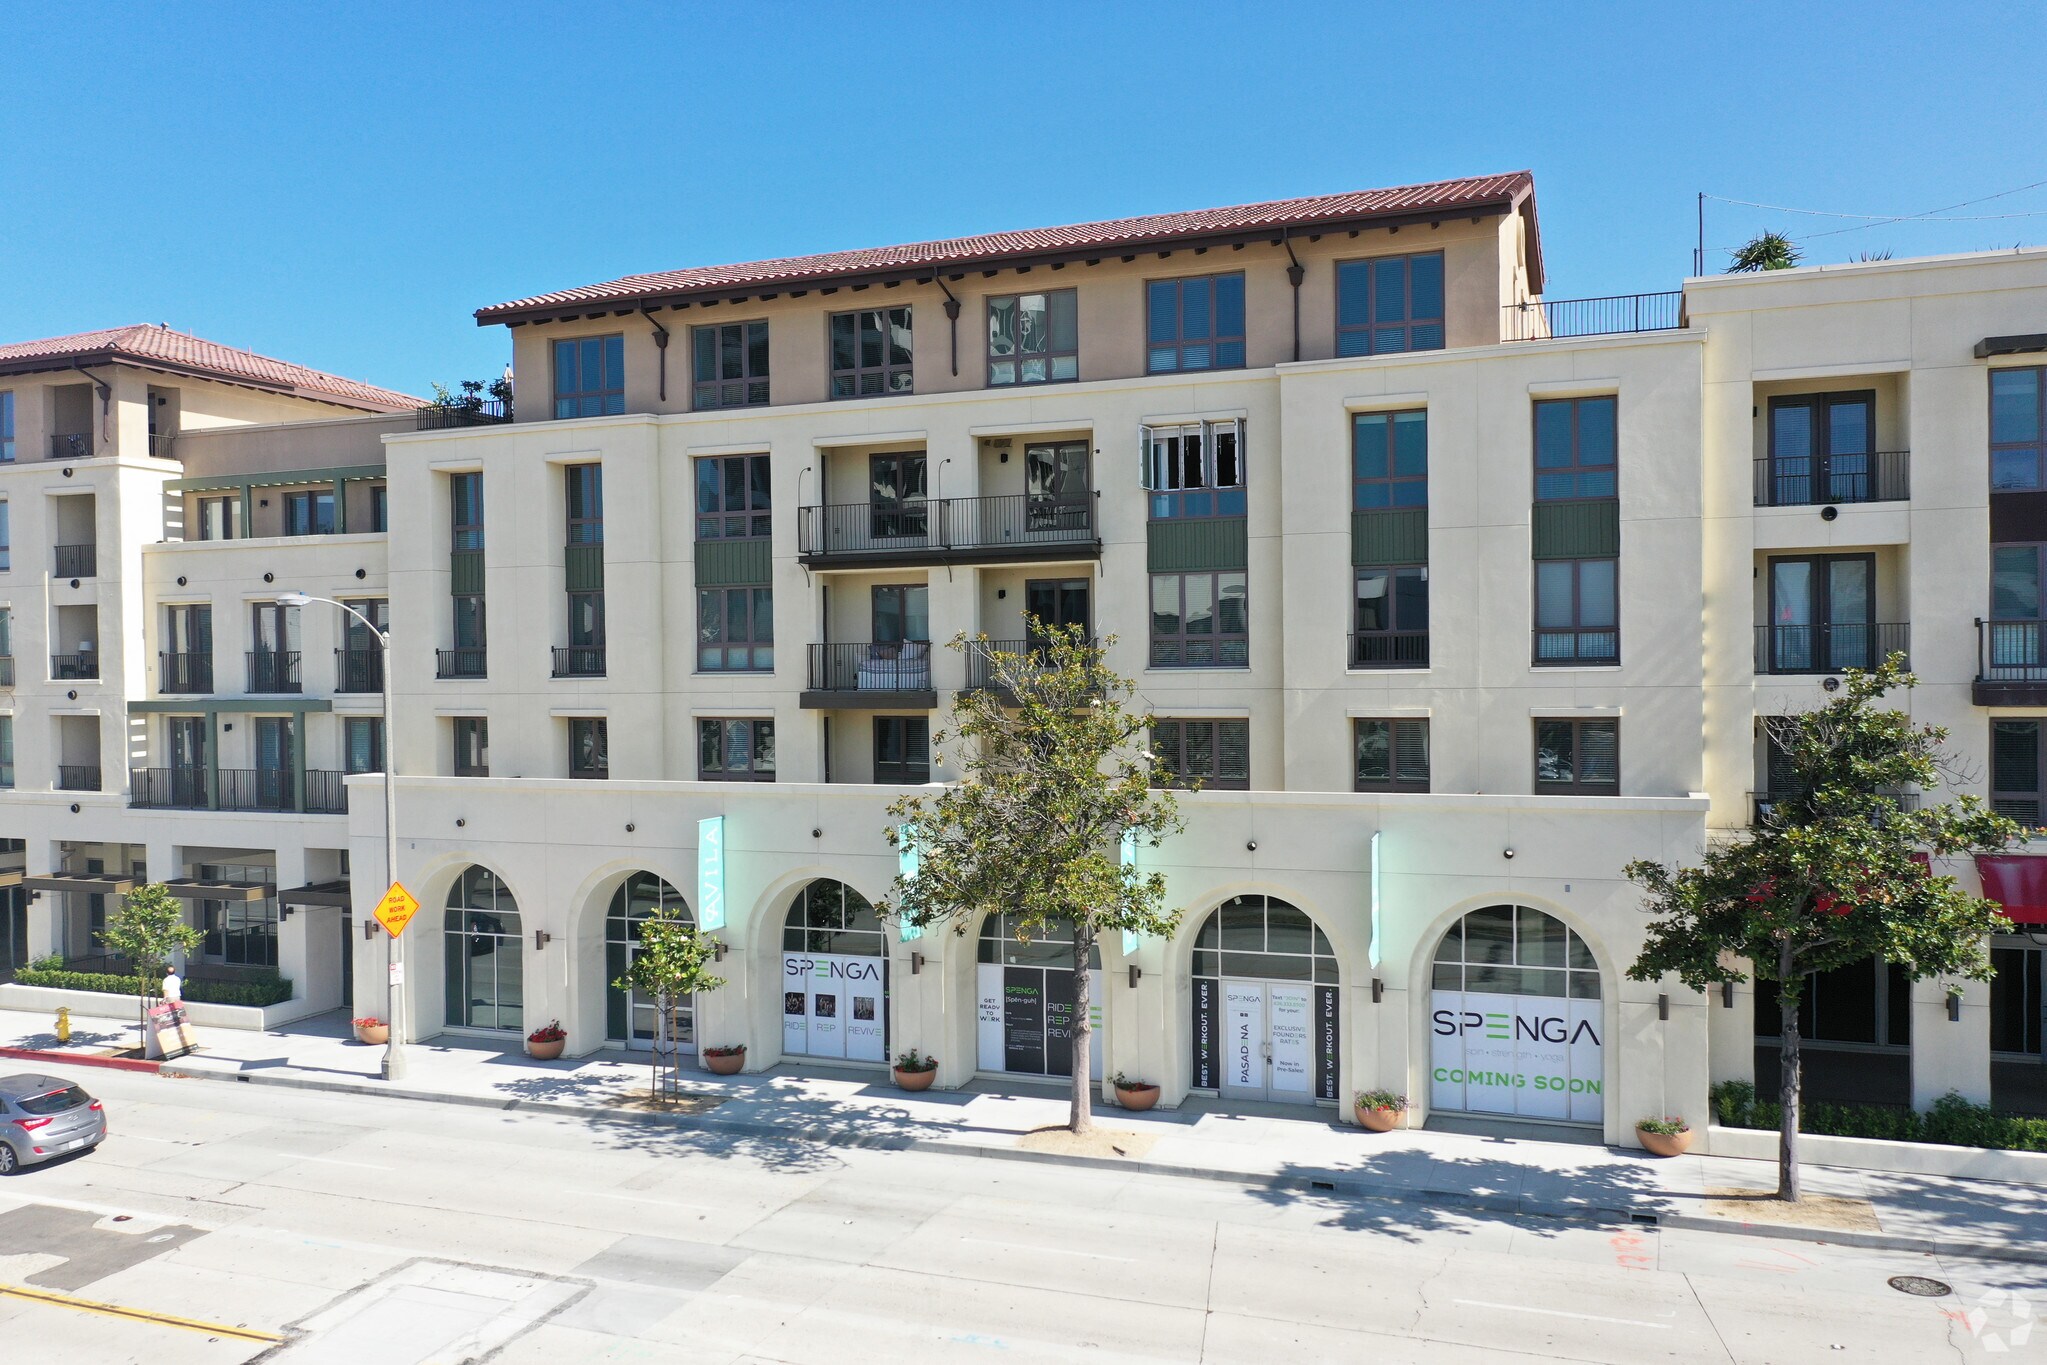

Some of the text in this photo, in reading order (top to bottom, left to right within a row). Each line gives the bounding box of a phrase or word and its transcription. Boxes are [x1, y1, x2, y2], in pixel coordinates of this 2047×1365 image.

[705, 825, 721, 922] AVILA
[389, 905, 405, 913] WORK
[386, 914, 407, 923] AHEAD
[786, 958, 880, 981] SPENGA
[1005, 986, 1039, 995] SPENGA
[1227, 994, 1261, 1003] SPENGA
[1048, 1003, 1072, 1013] RIDE
[1048, 1015, 1070, 1025] REP
[785, 1021, 806, 1031] RIDE
[816, 1023, 836, 1032] REP
[848, 1026, 882, 1036] REVIVE
[1433, 1010, 1601, 1046] SPENGA
[1048, 1028, 1071, 1038] REVI
[1325, 988, 1335, 1098] BEST. WERKOUT. EVER.
[1241, 1024, 1249, 1083] PASADENA
[1540, 1053, 1564, 1064] yoga
[1433, 1068, 1601, 1095] COMING SOON
